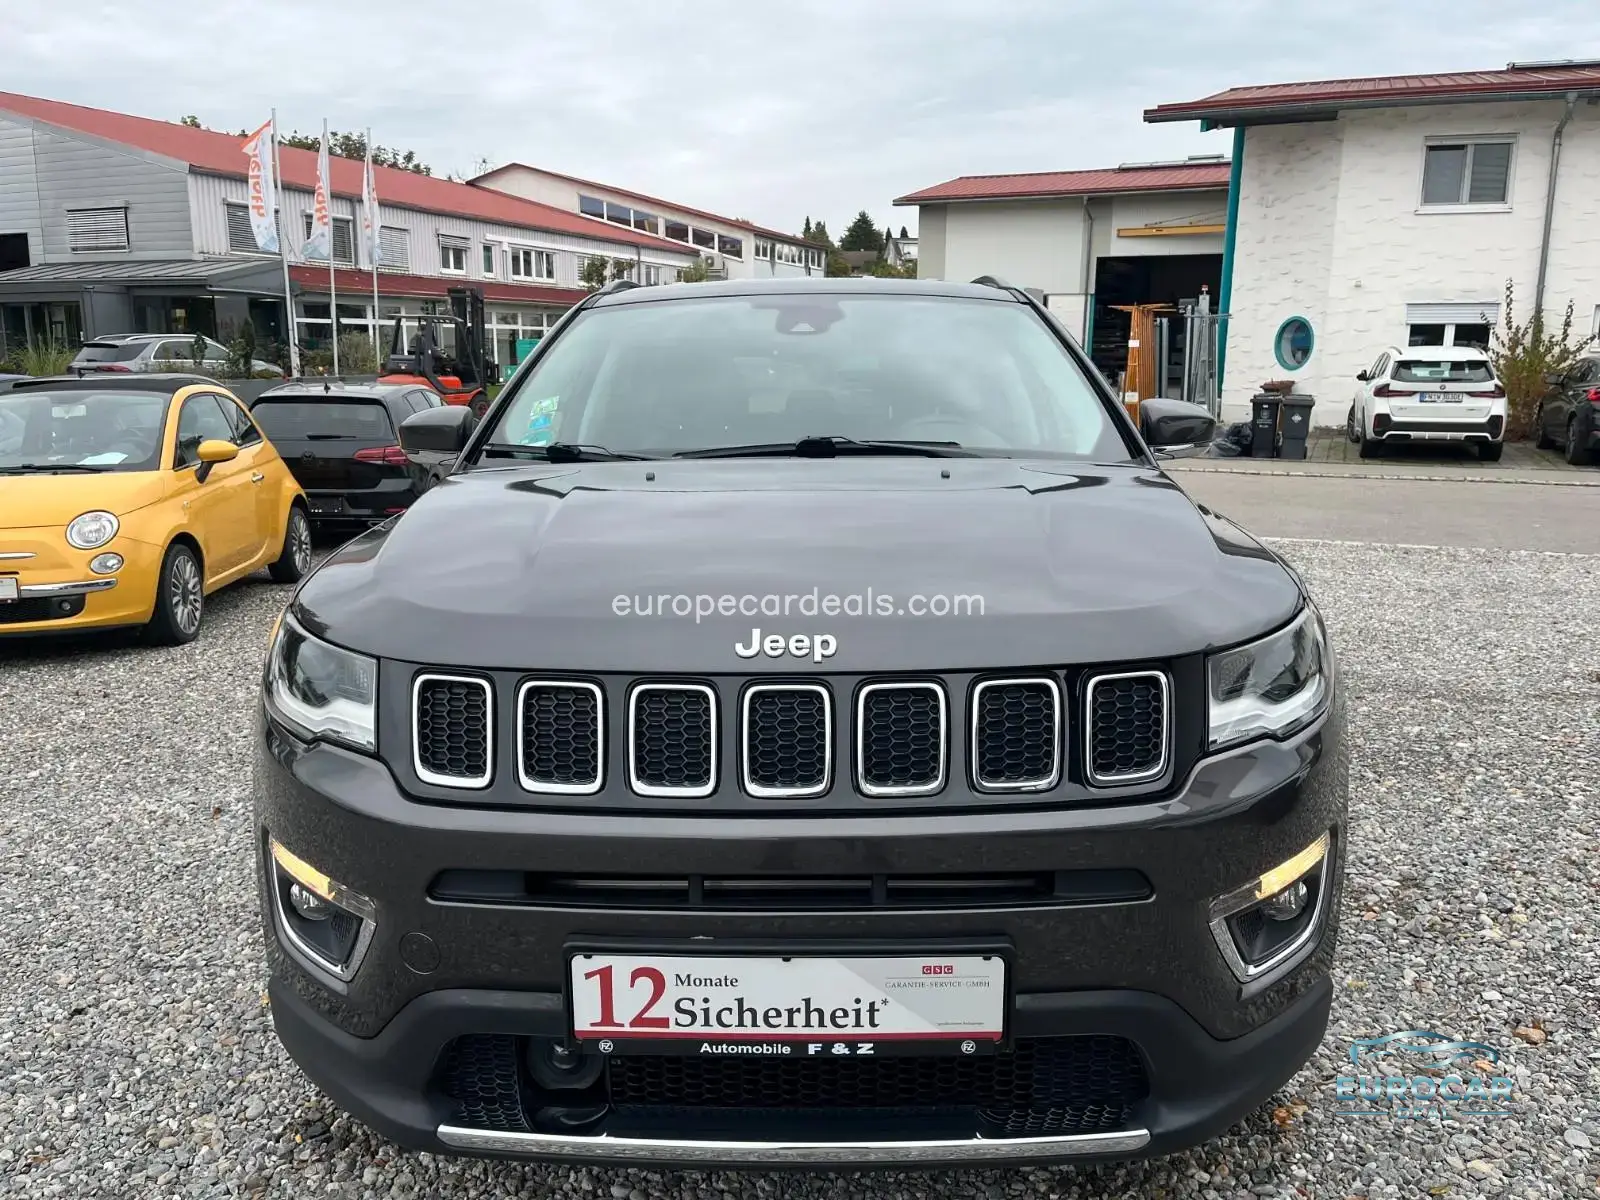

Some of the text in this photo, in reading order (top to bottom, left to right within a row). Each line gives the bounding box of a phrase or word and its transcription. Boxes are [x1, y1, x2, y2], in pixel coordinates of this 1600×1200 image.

[735, 628, 838, 663] Jeep
[922, 965, 953, 975] GSG
[674, 973, 739, 988] Monate
[584, 965, 670, 1029] 12
[700, 1042, 874, 1055] Automobile F & Z
